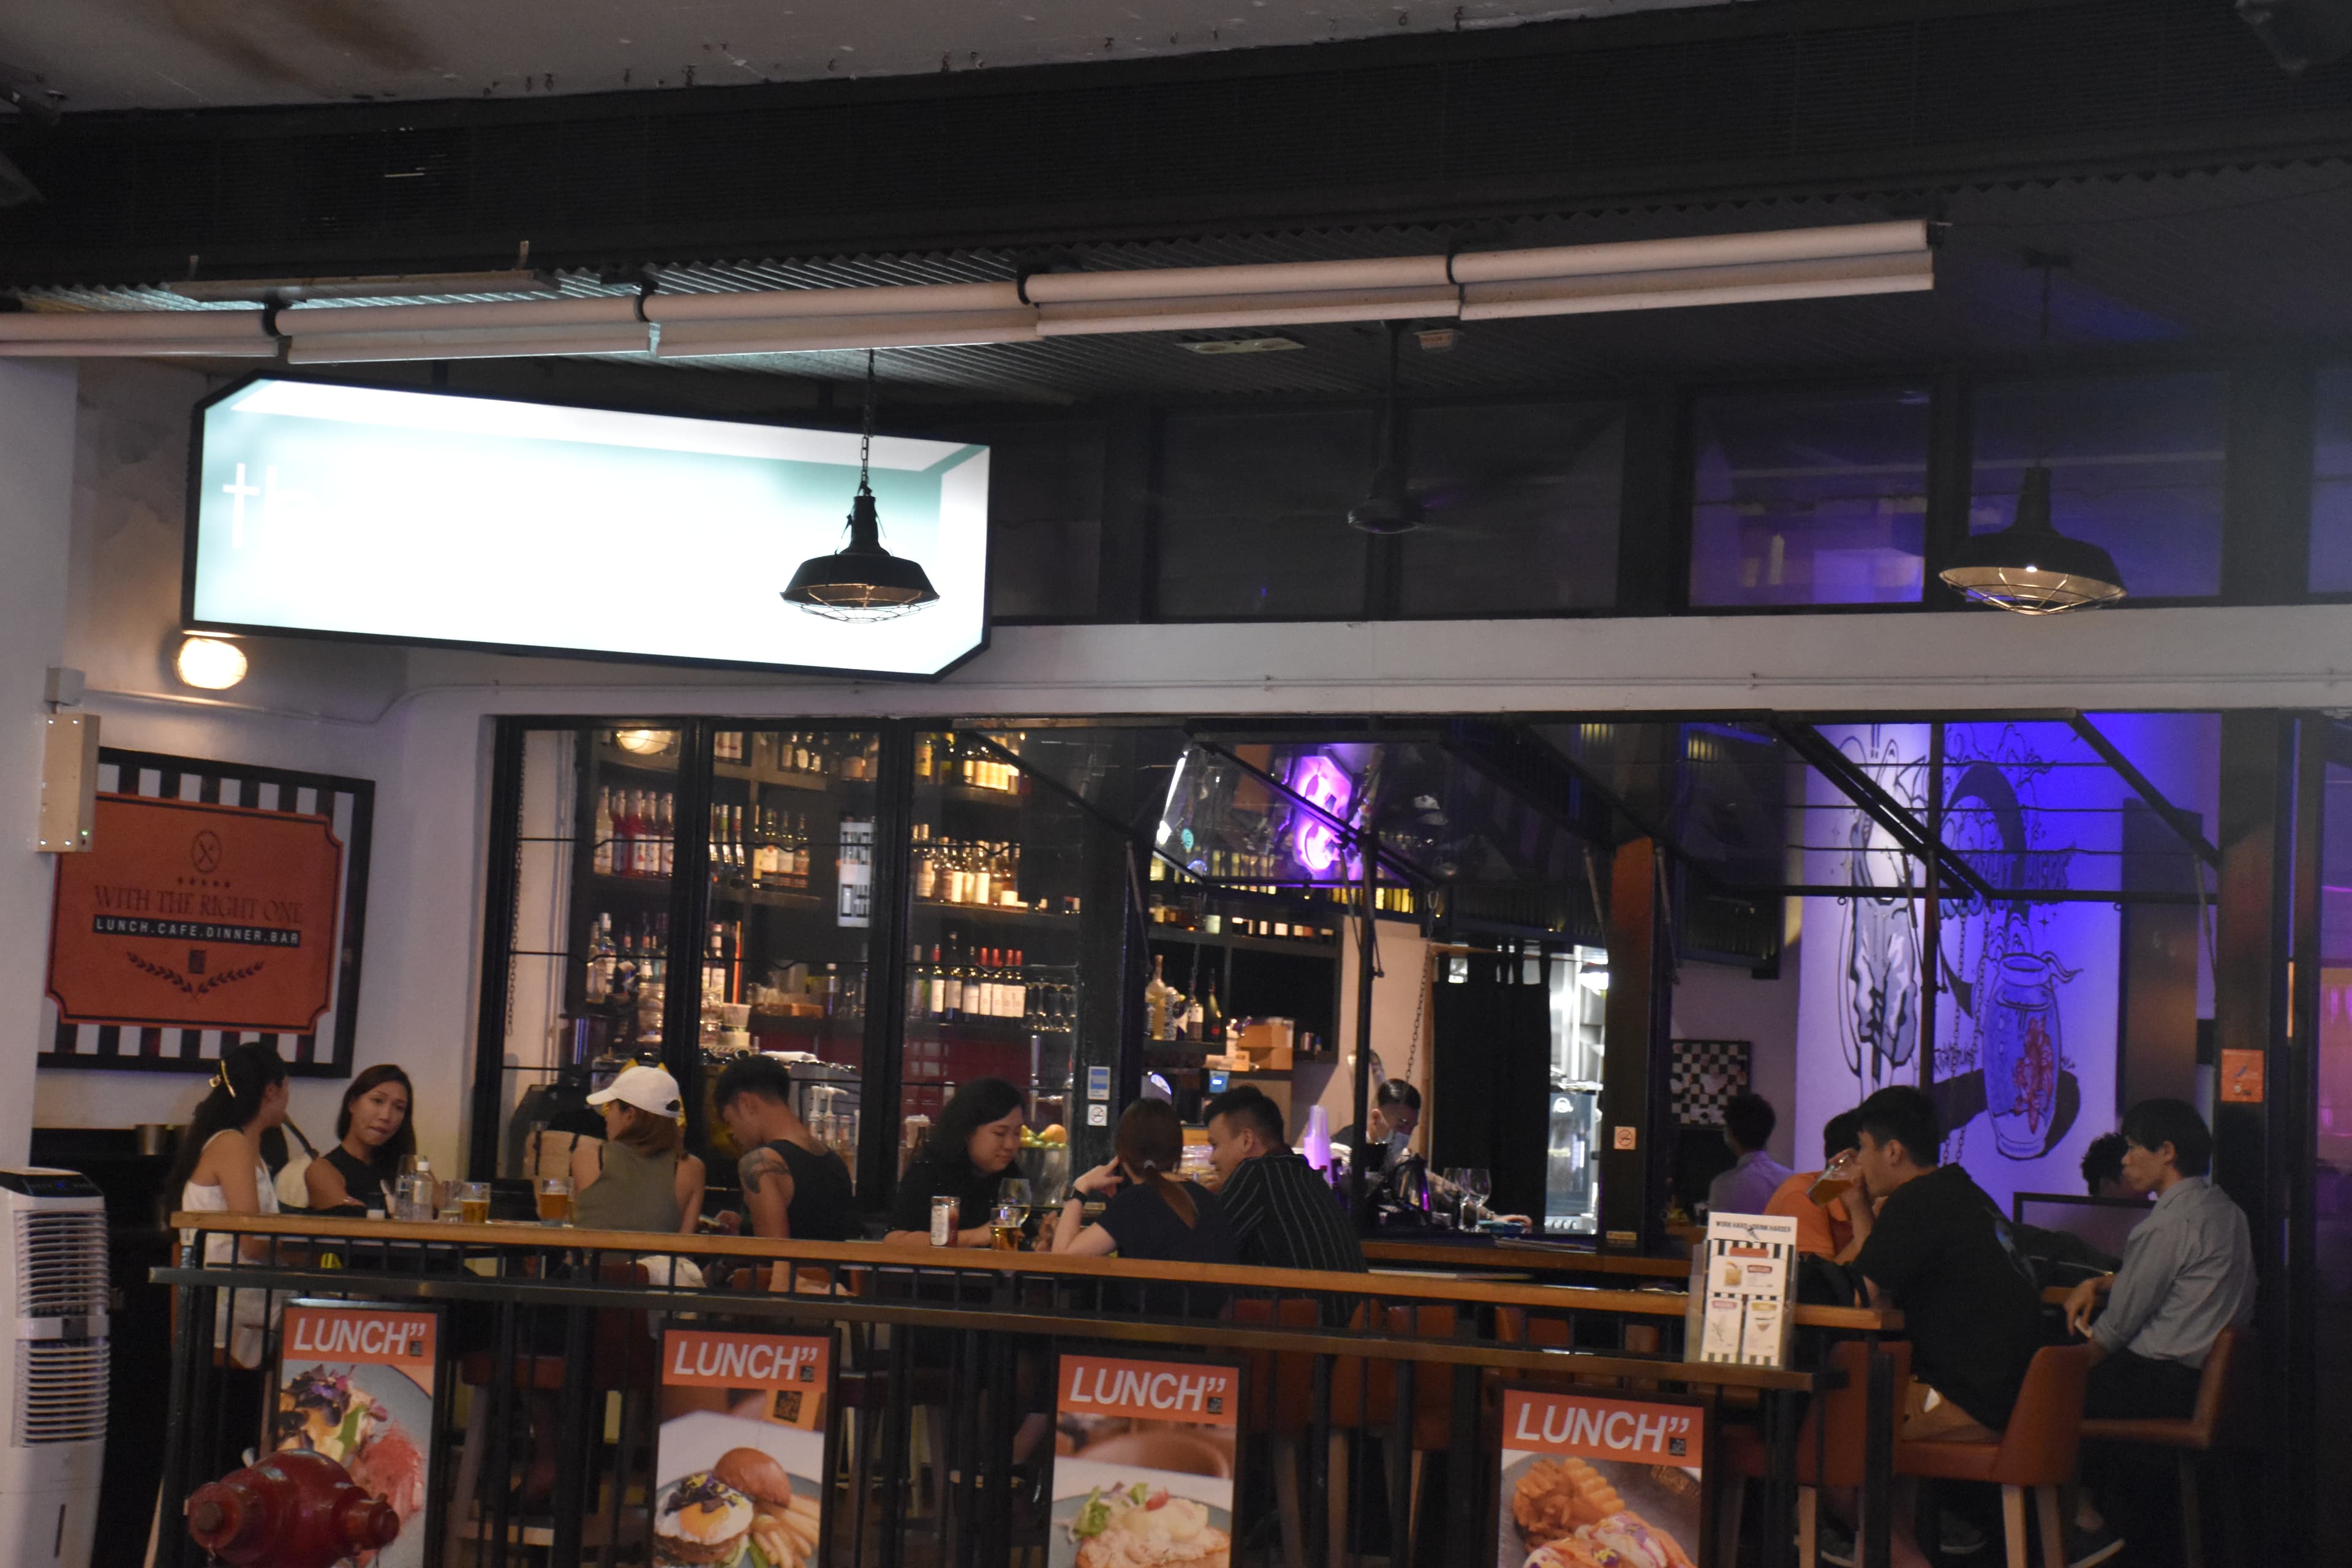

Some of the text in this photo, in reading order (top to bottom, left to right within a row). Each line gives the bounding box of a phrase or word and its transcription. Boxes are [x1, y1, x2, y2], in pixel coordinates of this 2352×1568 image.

[95, 885, 303, 924] WITH THE RIGHT ONE
